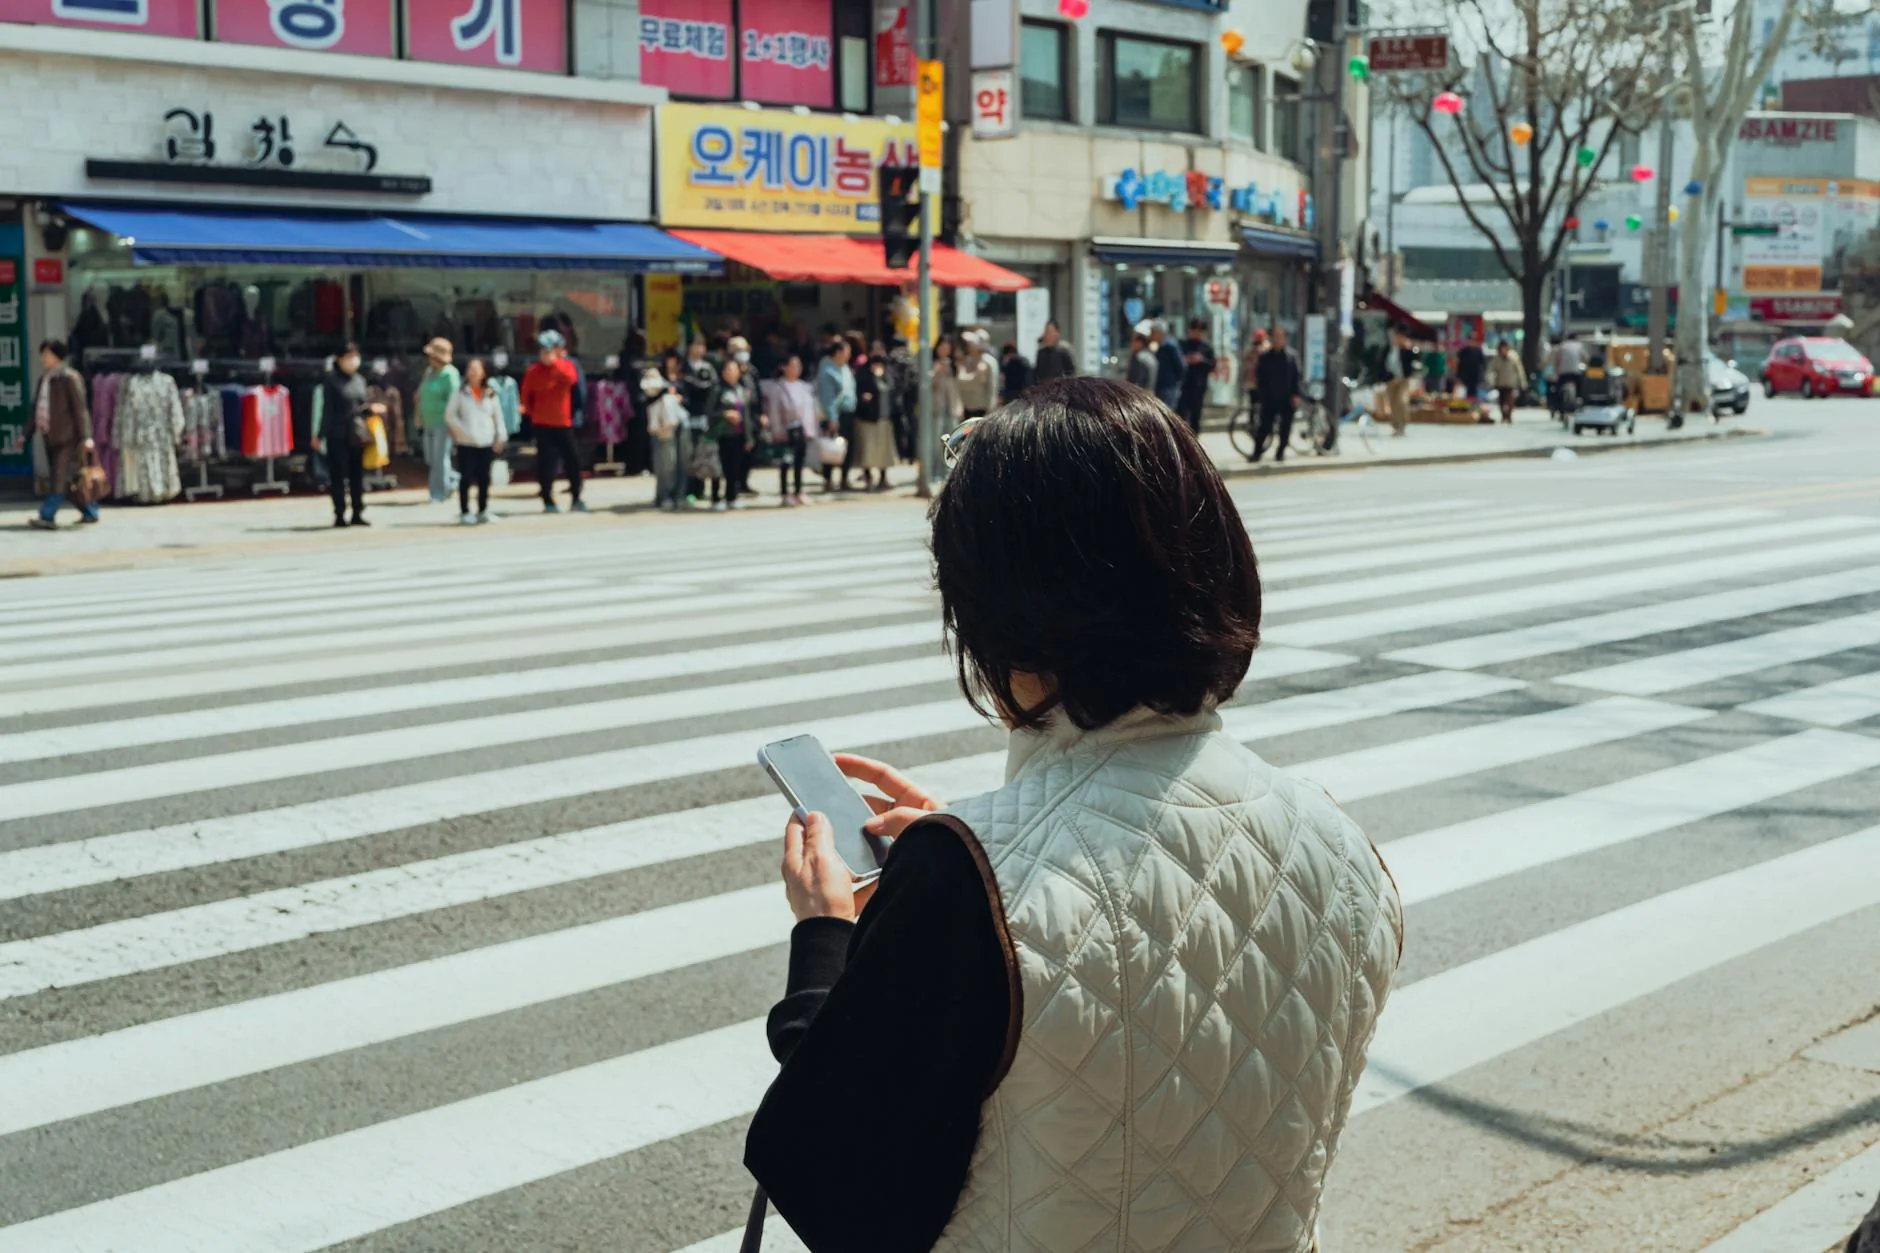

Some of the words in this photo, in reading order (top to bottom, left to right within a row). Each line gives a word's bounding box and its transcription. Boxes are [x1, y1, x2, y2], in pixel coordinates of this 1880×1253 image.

[639, 18, 727, 59] 무료체험
[745, 30, 830, 70] 1+1행사
[975, 88, 1006, 128] 약
